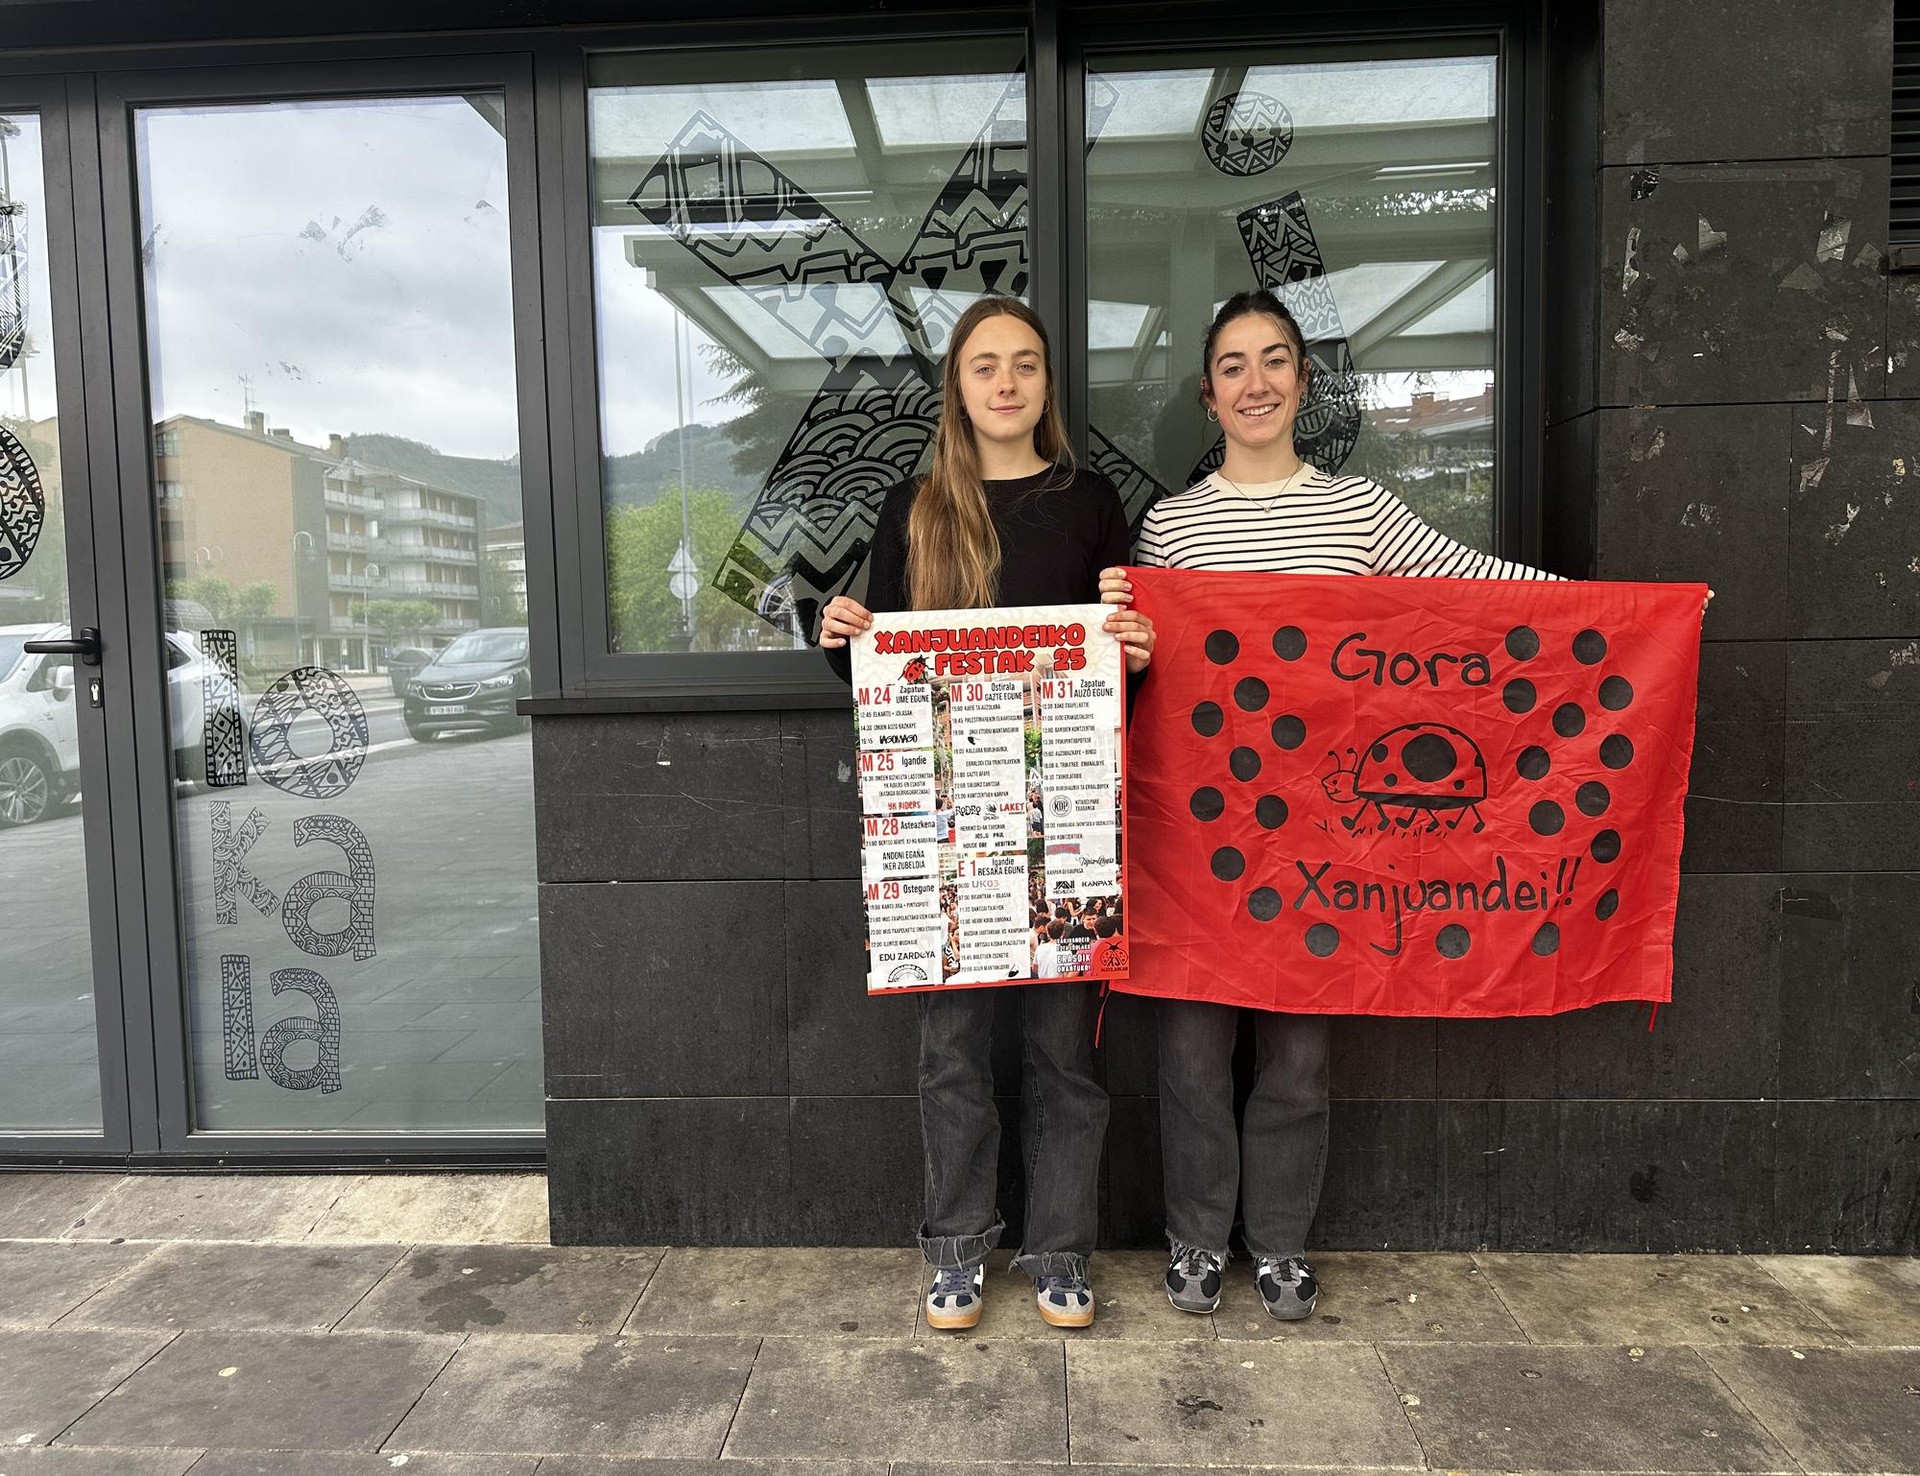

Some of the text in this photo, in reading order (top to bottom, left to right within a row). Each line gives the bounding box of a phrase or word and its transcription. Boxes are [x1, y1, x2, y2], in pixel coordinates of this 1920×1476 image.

[874, 623, 1086, 655] XANJUANDEIKO
[934, 648, 1087, 676] FESTAK 25
[1330, 632, 1491, 688] Gora
[900, 685, 925, 694] Zapatue
[991, 682, 1015, 691] Ostirala
[1042, 680, 1073, 699] M 31
[1081, 679, 1105, 688] Zapatue
[859, 686, 891, 705] M 24
[896, 694, 930, 704] UME EGUNE
[951, 683, 983, 702] M 30
[985, 692, 1022, 701] GAZTE EGUNE
[1074, 688, 1114, 698] AUZO EGUNE
[862, 754, 926, 772] M 25 Igandie
[1000, 803, 1025, 812] LAKET
[867, 818, 935, 836] M 28 Asteazkena
[883, 852, 904, 860] ANDONI
[883, 861, 925, 870] IKER ZUBELDIA
[958, 857, 1014, 877] E 1 Igandie
[978, 866, 1025, 876] RESAKA EGUNE
[868, 882, 934, 900] M 29 Ostegune
[1293, 856, 1582, 956] Xanjuandei!!
[879, 953, 895, 961] EDU
